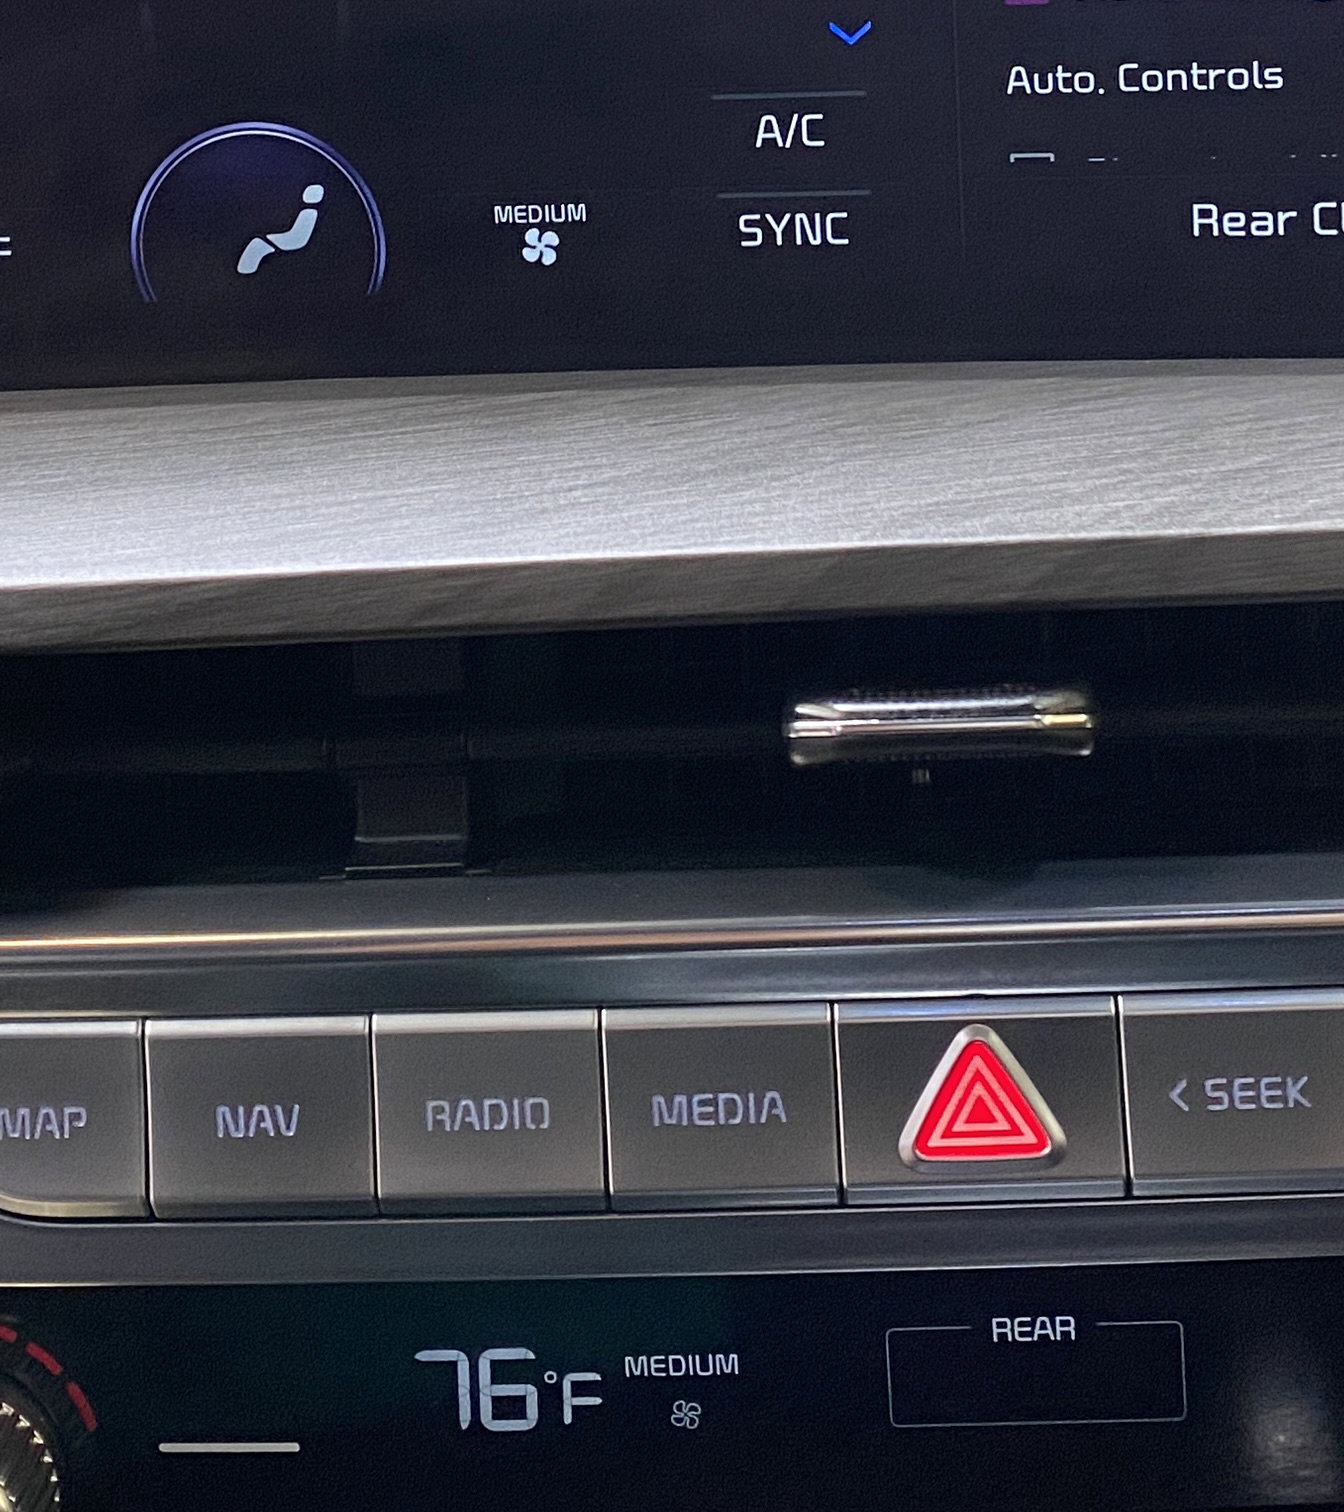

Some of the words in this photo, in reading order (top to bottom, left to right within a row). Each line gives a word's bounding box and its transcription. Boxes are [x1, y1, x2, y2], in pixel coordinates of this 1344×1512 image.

[1007, 65, 1104, 94] Auto.
[1119, 61, 1283, 91] Controls
[756, 114, 825, 148] A/C
[494, 204, 586, 223] MEDIUM
[739, 212, 849, 246] SYNC
[1193, 204, 1297, 236] Rear
[652, 1091, 786, 1126] MEDIA
[1205, 1076, 1311, 1110] SEEK
[216, 1104, 299, 1138] NAV
[426, 1097, 549, 1131] RADIO
[992, 1316, 1075, 1342] REAR
[625, 1354, 738, 1377] MEDIUM
